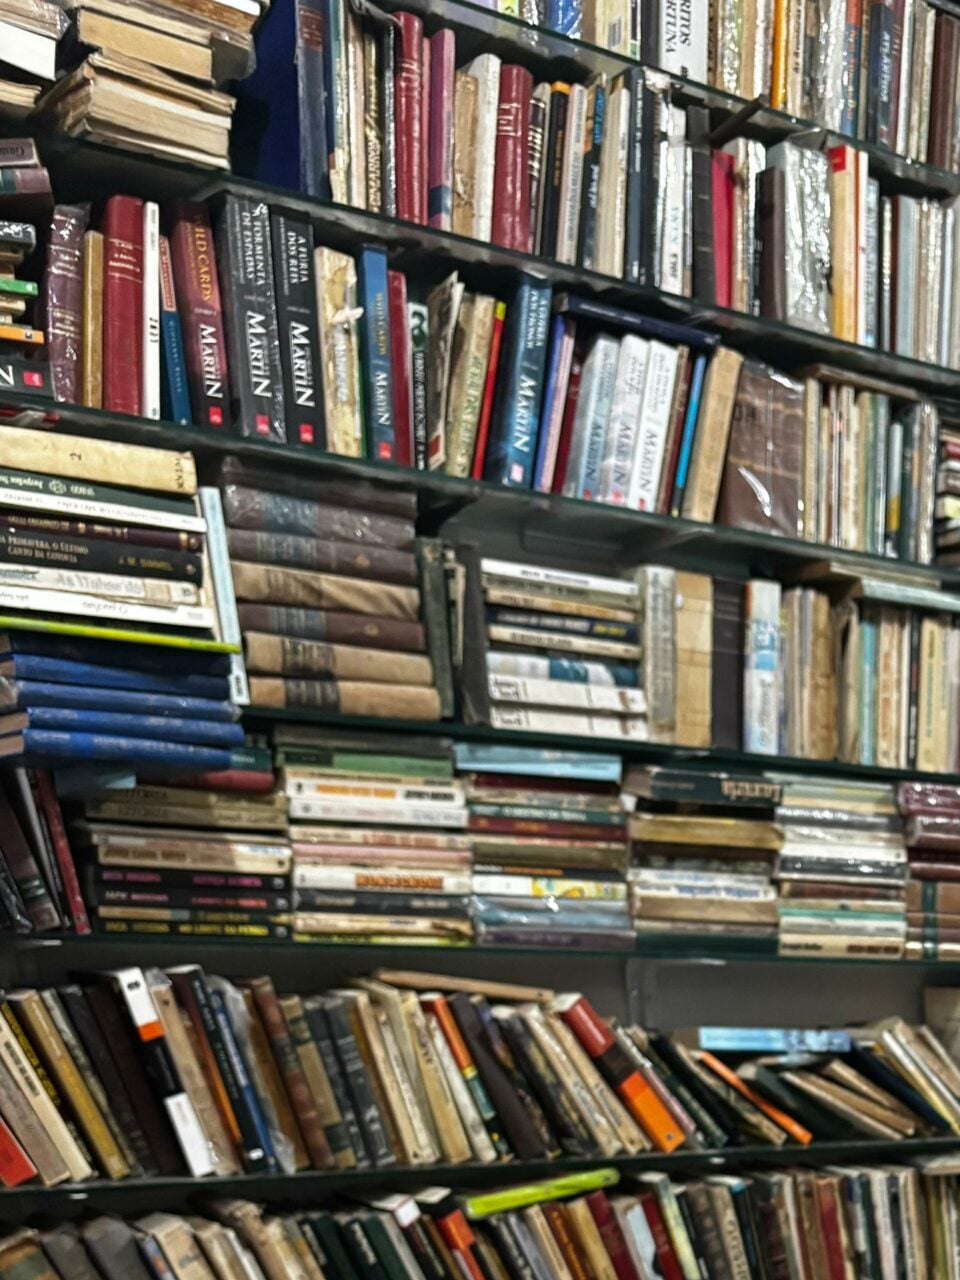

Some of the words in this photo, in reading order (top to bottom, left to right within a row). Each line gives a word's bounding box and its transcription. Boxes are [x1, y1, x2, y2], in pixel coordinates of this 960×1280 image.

[200, 324, 223, 398] MARTIN
[247, 310, 273, 398] MARTIN
[290, 321, 315, 407] MARTIN
[375, 371, 391, 425] MARTIN
[512, 376, 537, 453] MARTIN
